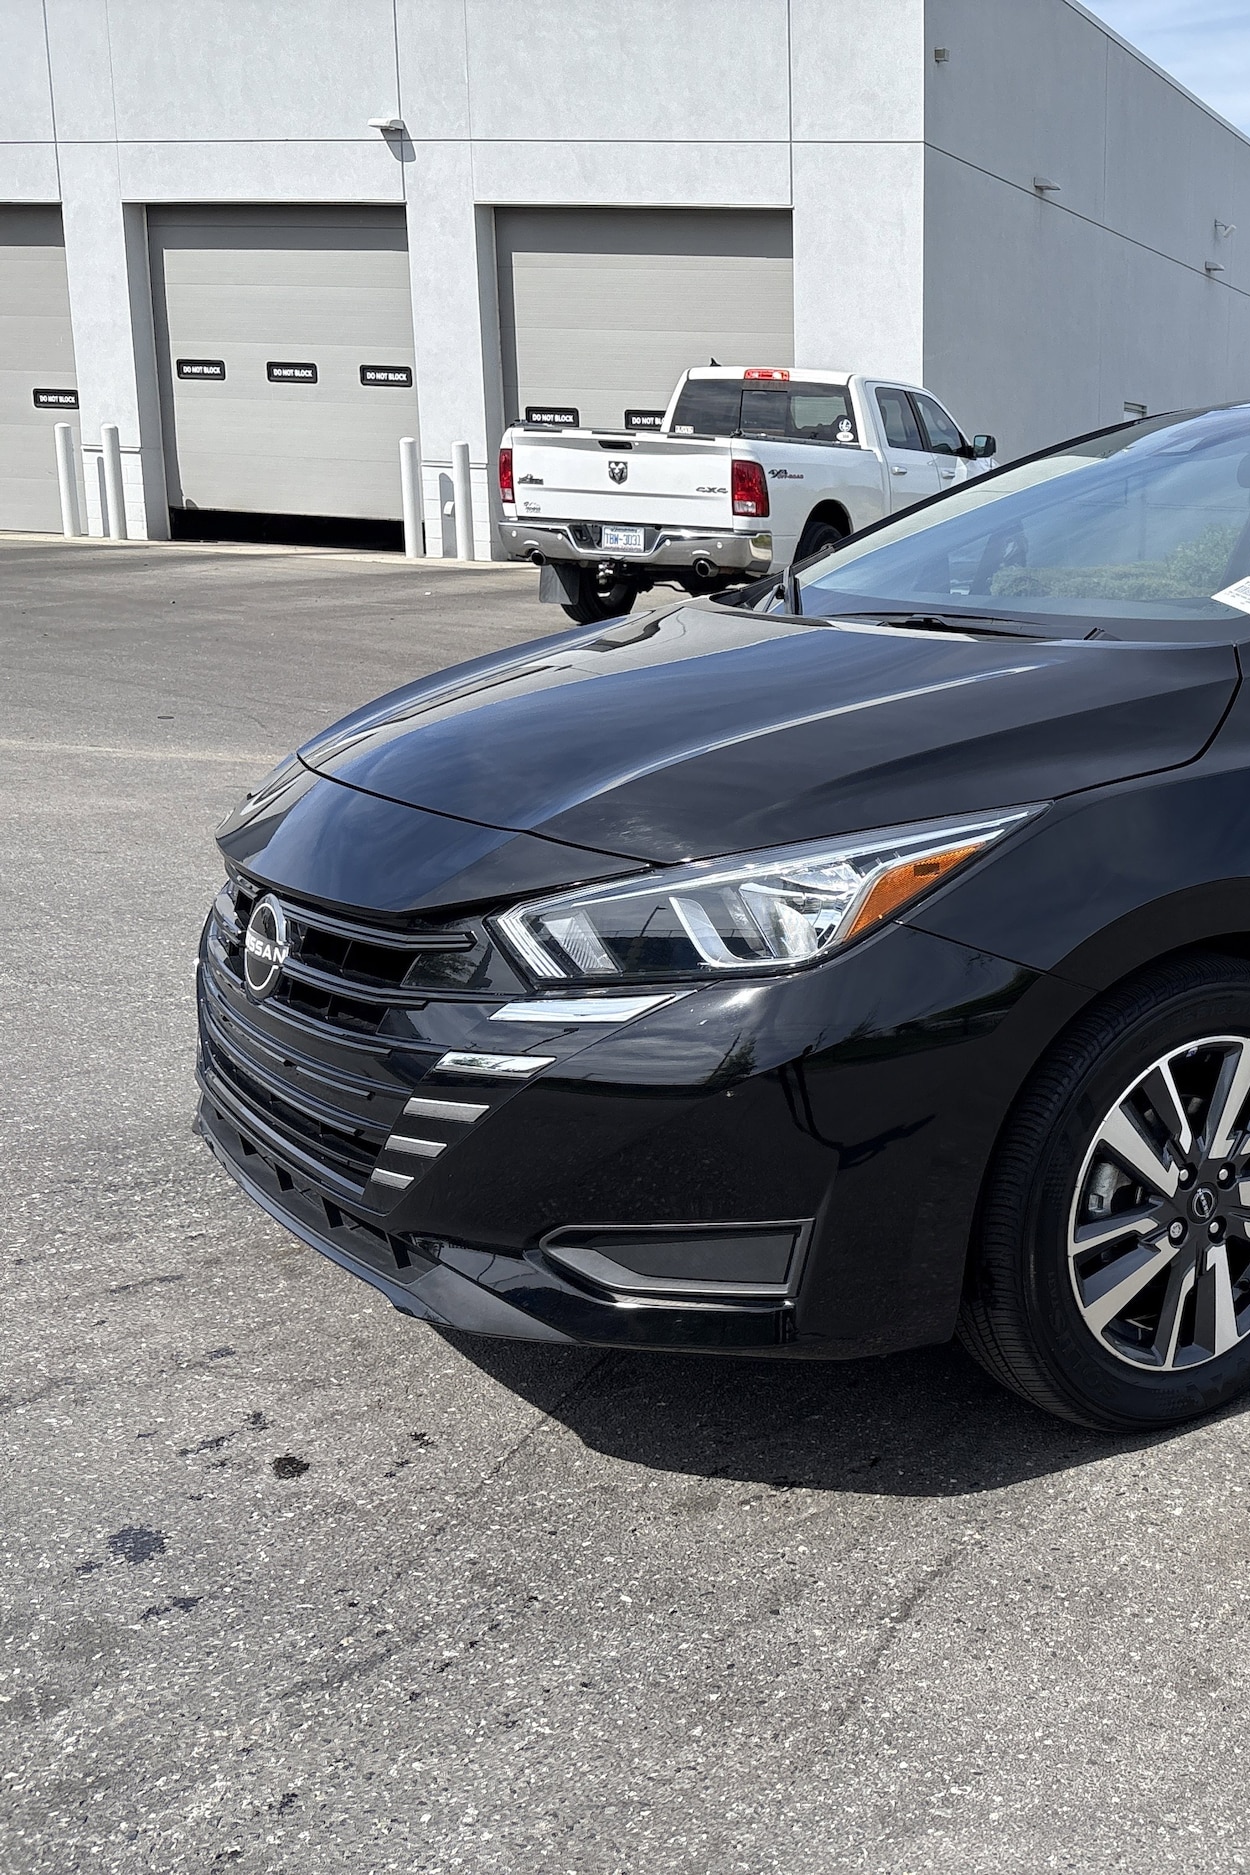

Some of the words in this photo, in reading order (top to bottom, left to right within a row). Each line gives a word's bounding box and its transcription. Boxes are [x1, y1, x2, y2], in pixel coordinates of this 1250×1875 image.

[203, 366, 220, 374] BLOCK
[273, 368, 282, 376] DO
[294, 369, 312, 377] BLOCK
[388, 373, 407, 381] BLOCK
[48, 395, 58, 403] NOT
[532, 413, 541, 421] DO
[555, 414, 573, 422] BLOCK
[642, 417, 654, 425] NOT
